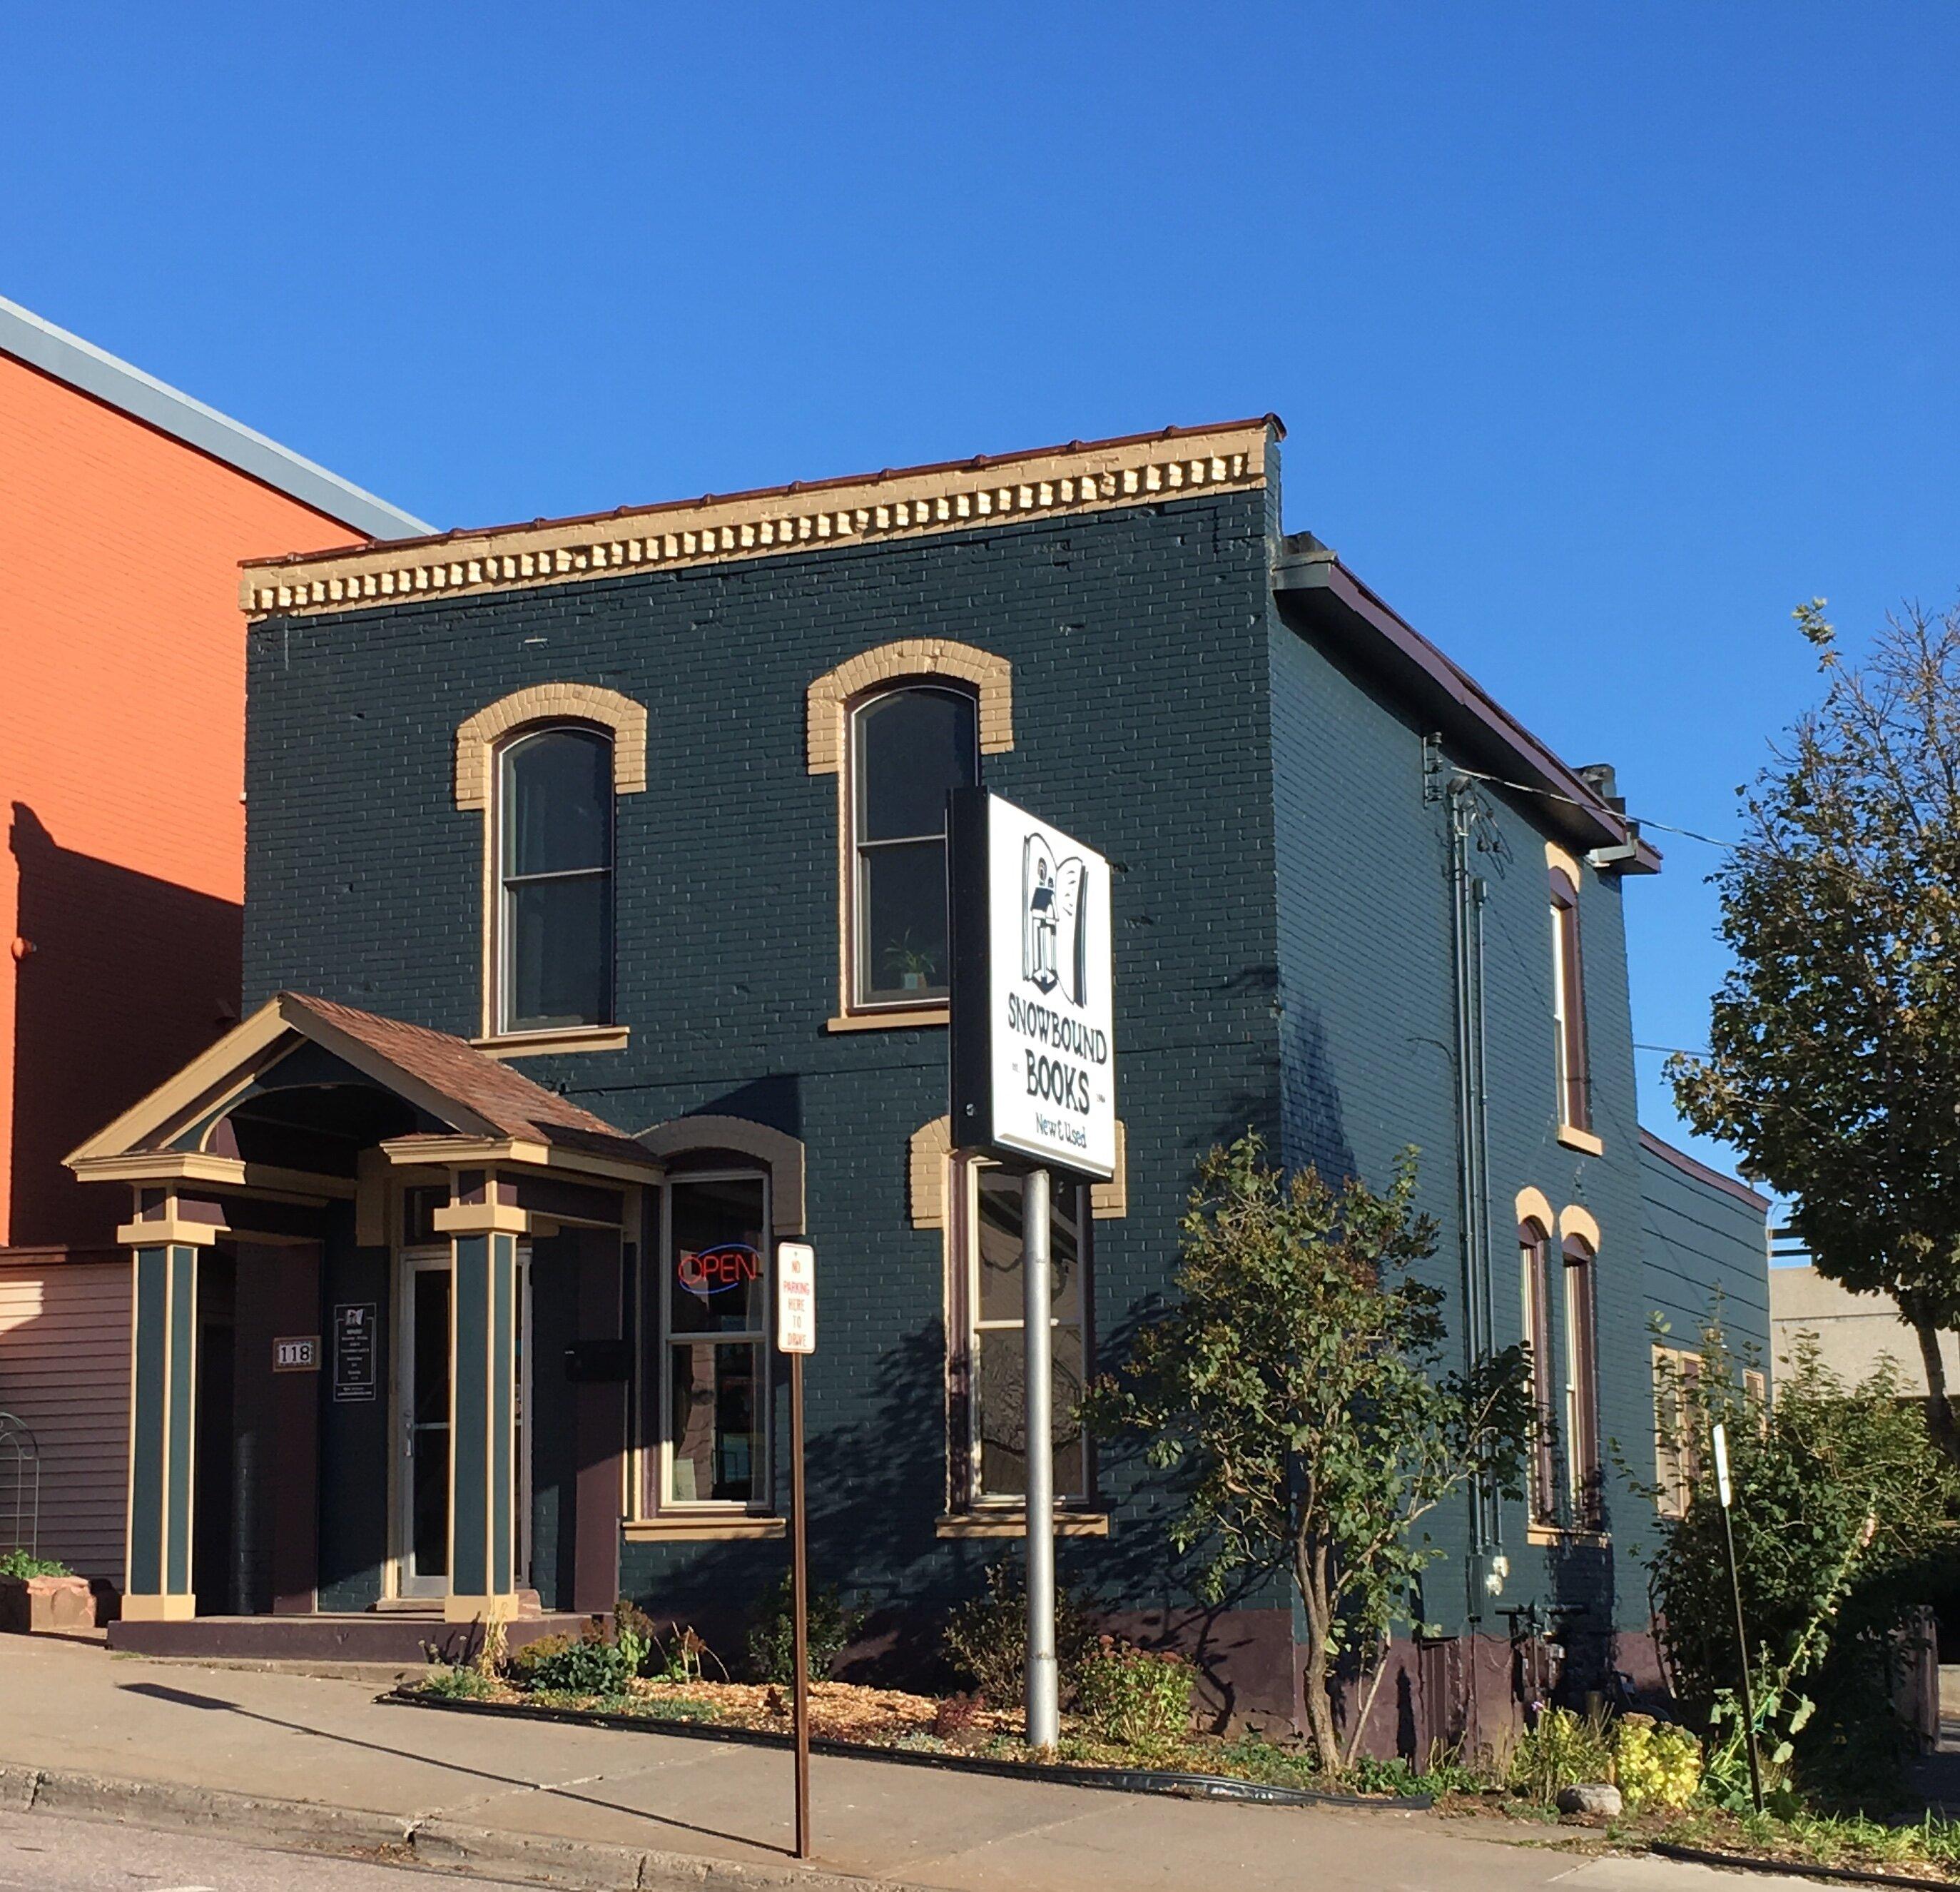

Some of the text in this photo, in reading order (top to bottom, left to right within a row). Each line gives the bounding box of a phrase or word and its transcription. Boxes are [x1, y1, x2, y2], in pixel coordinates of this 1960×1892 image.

[1008, 992, 1107, 1065] SNOWBOUND
[1025, 1048, 1090, 1115] BOOKS
[679, 1253, 757, 1285] OPEN
[791, 1260, 801, 1273] NO
[783, 1281, 810, 1295] PARKING
[788, 1298, 805, 1312] HERE
[793, 1315, 801, 1328] TO
[788, 1333, 806, 1347] DRIVE
[281, 1345, 310, 1362] 118
